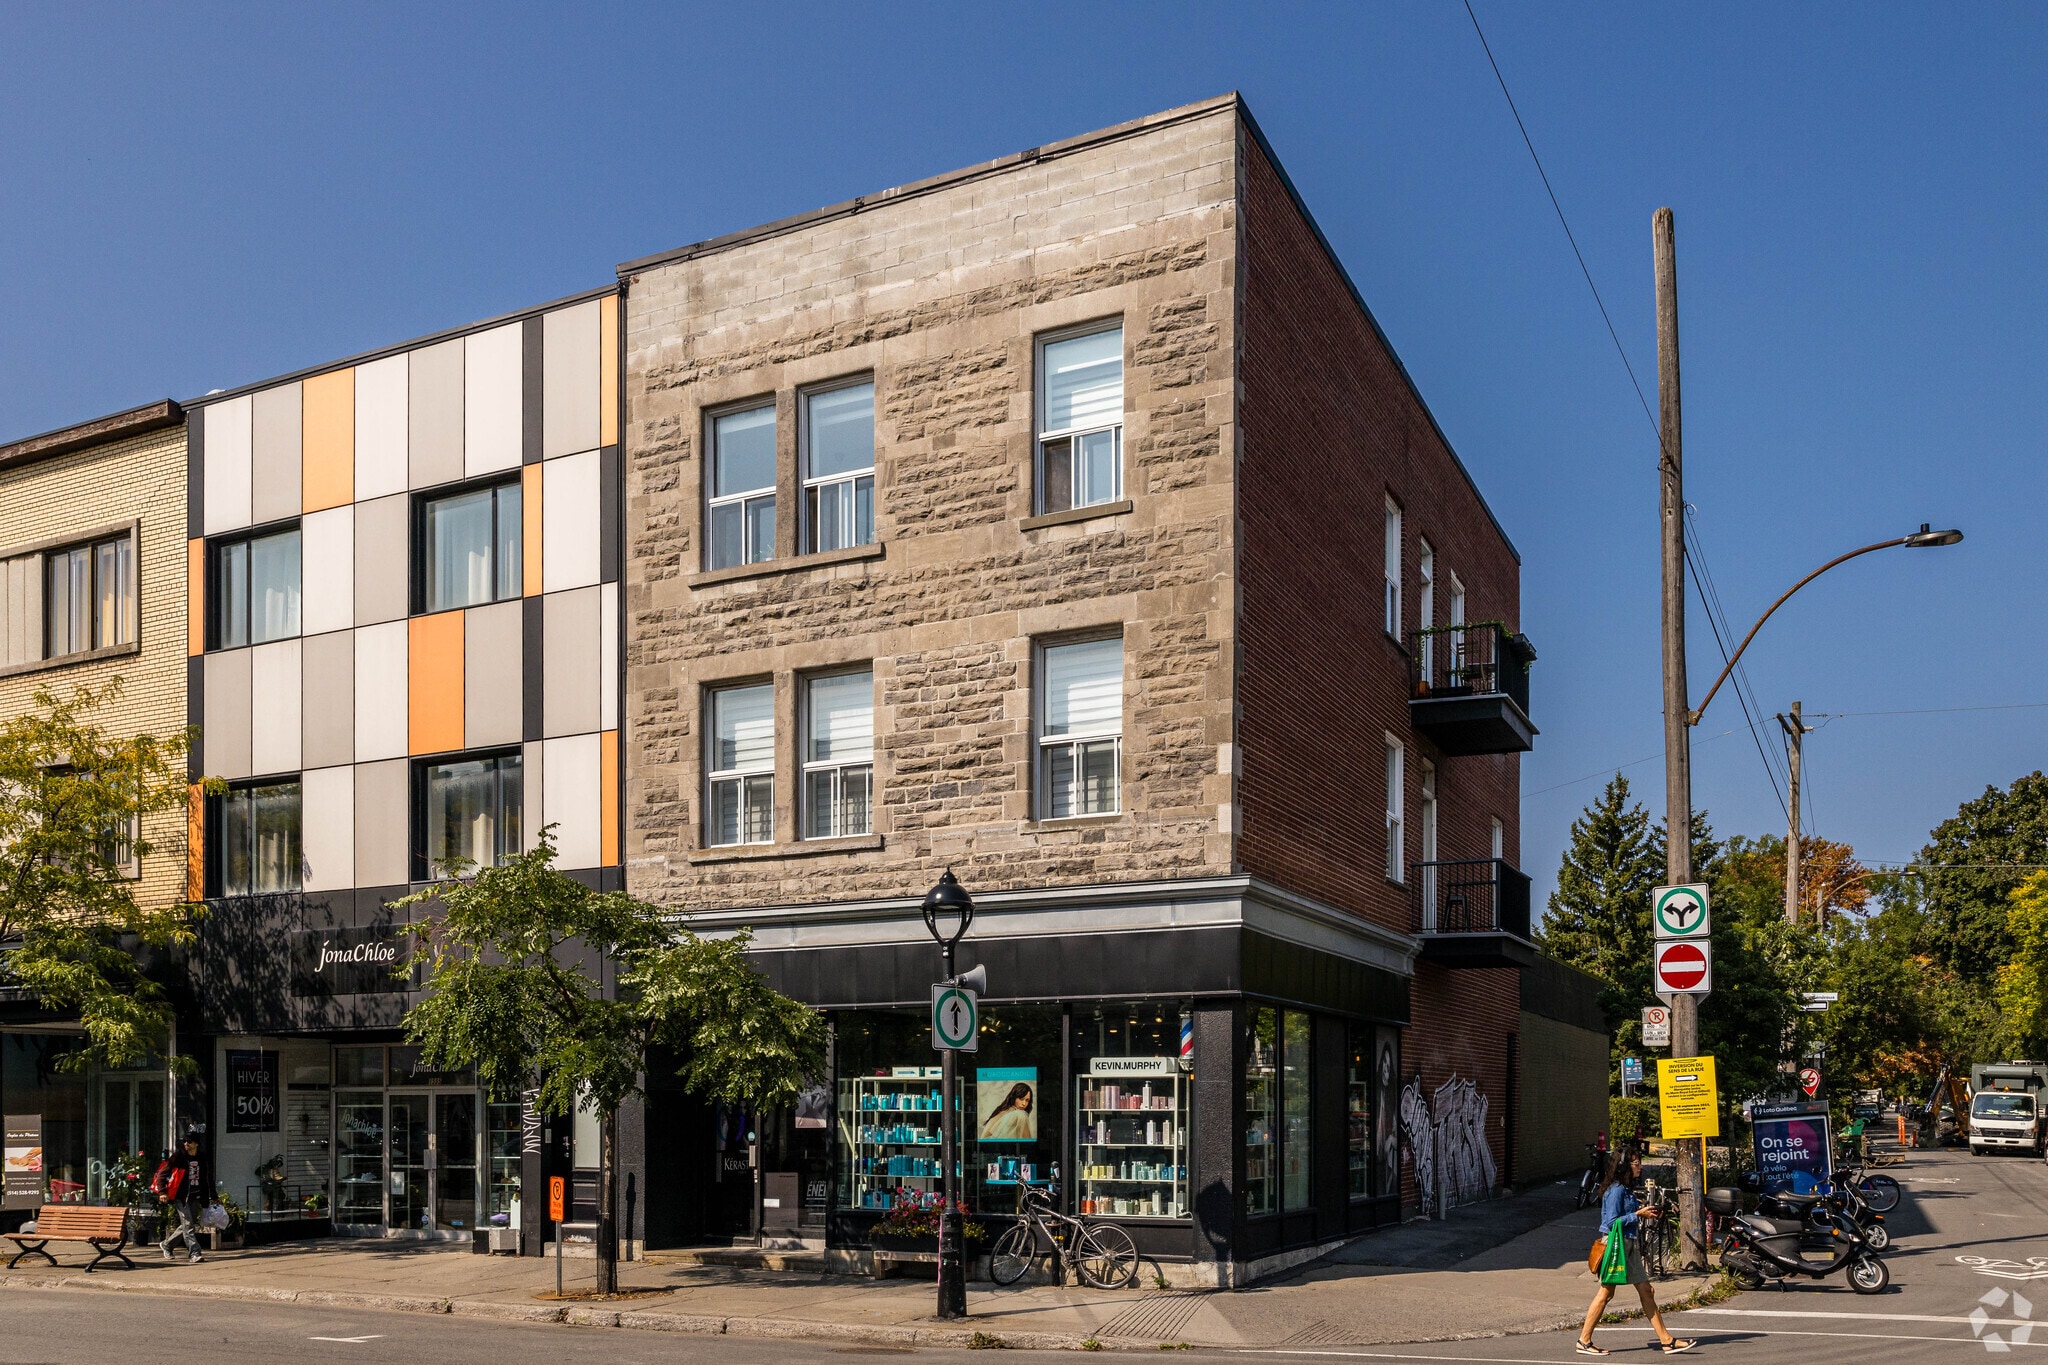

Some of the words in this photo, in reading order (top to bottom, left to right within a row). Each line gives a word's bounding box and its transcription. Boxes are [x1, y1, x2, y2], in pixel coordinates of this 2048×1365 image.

[314, 940, 395, 972] jonaChloe
[1095, 1061, 1162, 1070] KEVIN.MURPHY
[238, 1070, 270, 1083] HIVER
[237, 1096, 274, 1115] 50%
[1761, 1137, 1783, 1149] On
[1786, 1137, 1803, 1147] se
[1762, 1148, 1810, 1164] rejoint
[1770, 1164, 1787, 1172] vélo
